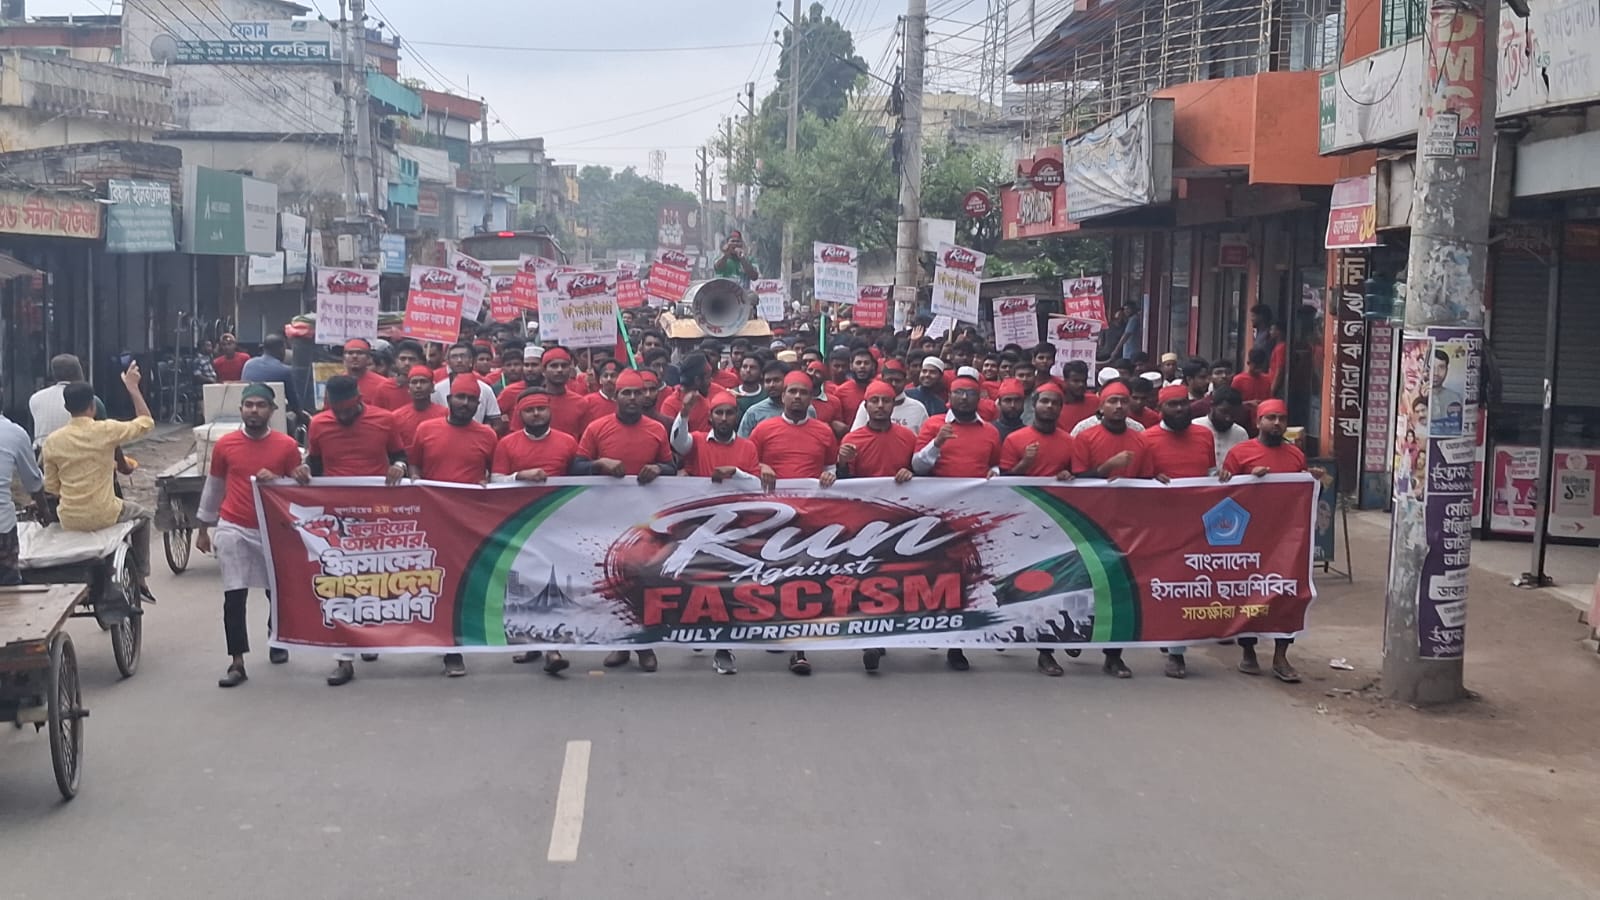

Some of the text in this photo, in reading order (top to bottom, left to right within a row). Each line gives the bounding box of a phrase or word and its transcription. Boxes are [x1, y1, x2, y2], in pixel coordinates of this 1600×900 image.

[227, 43, 264, 56] ঢাকা
[824, 246, 847, 257] Run
[949, 249, 974, 262] Run
[333, 271, 365, 285] Run
[425, 269, 455, 283] Run
[573, 274, 603, 289] Run
[1062, 320, 1089, 332] Run
[1445, 498, 1472, 516] মেডি
[649, 501, 967, 578] Run
[320, 549, 435, 576] ইনসাফের
[729, 556, 876, 585] Against
[1184, 552, 1261, 572] বাংলাদেশ
[314, 567, 445, 599] বাংলাদেশ
[1151, 573, 1298, 600] ইসলামী ছাত্রশিবির
[643, 573, 961, 626] FASCISM
[322, 594, 435, 627] বিনির্মাণ
[1181, 601, 1235, 620] সাতক্ষীরা
[662, 615, 963, 642] JULY UPRISING RUN-2026
